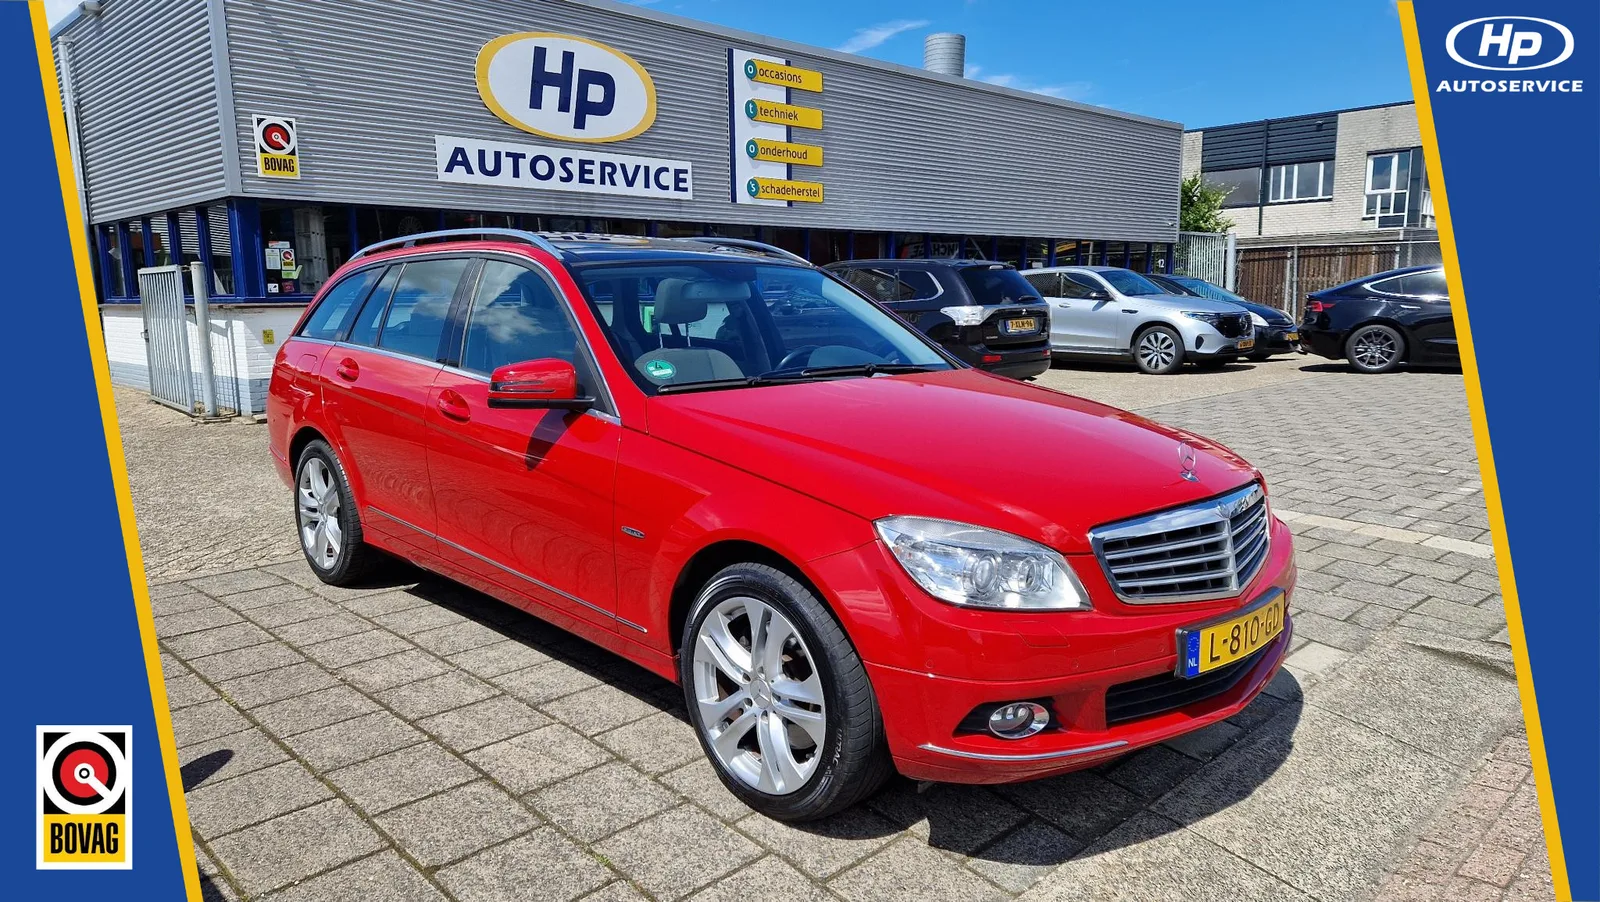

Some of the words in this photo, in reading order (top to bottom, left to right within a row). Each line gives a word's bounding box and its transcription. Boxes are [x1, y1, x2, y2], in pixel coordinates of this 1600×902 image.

[758, 67, 802, 84] occasions
[759, 105, 799, 121] techniek
[760, 145, 808, 160] onderhoud
[263, 157, 295, 173] BOVAG
[444, 147, 689, 193] AUTOSERVICE
[761, 184, 820, 198] schadeherstel
[1209, 603, 1280, 664] L-810-GD
[1188, 657, 1198, 668] NL
